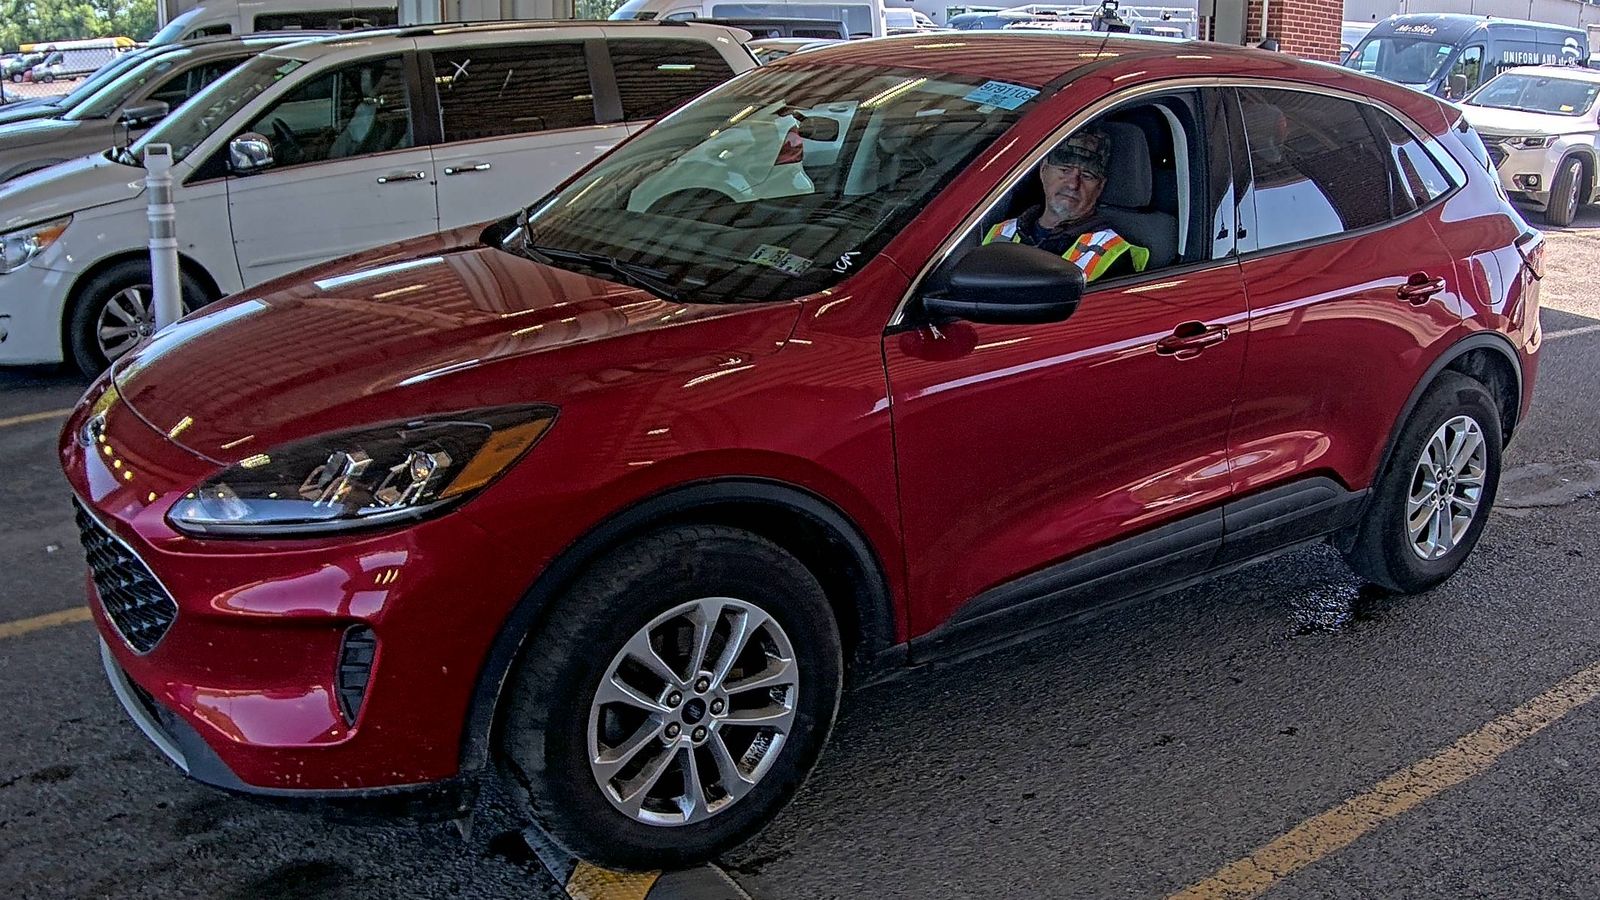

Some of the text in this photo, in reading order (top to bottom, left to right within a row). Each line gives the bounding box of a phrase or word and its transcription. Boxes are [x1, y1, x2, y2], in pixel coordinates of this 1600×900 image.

[1503, 51, 1557, 64] UNIFORM AND
[980, 83, 1035, 101] 9791105
